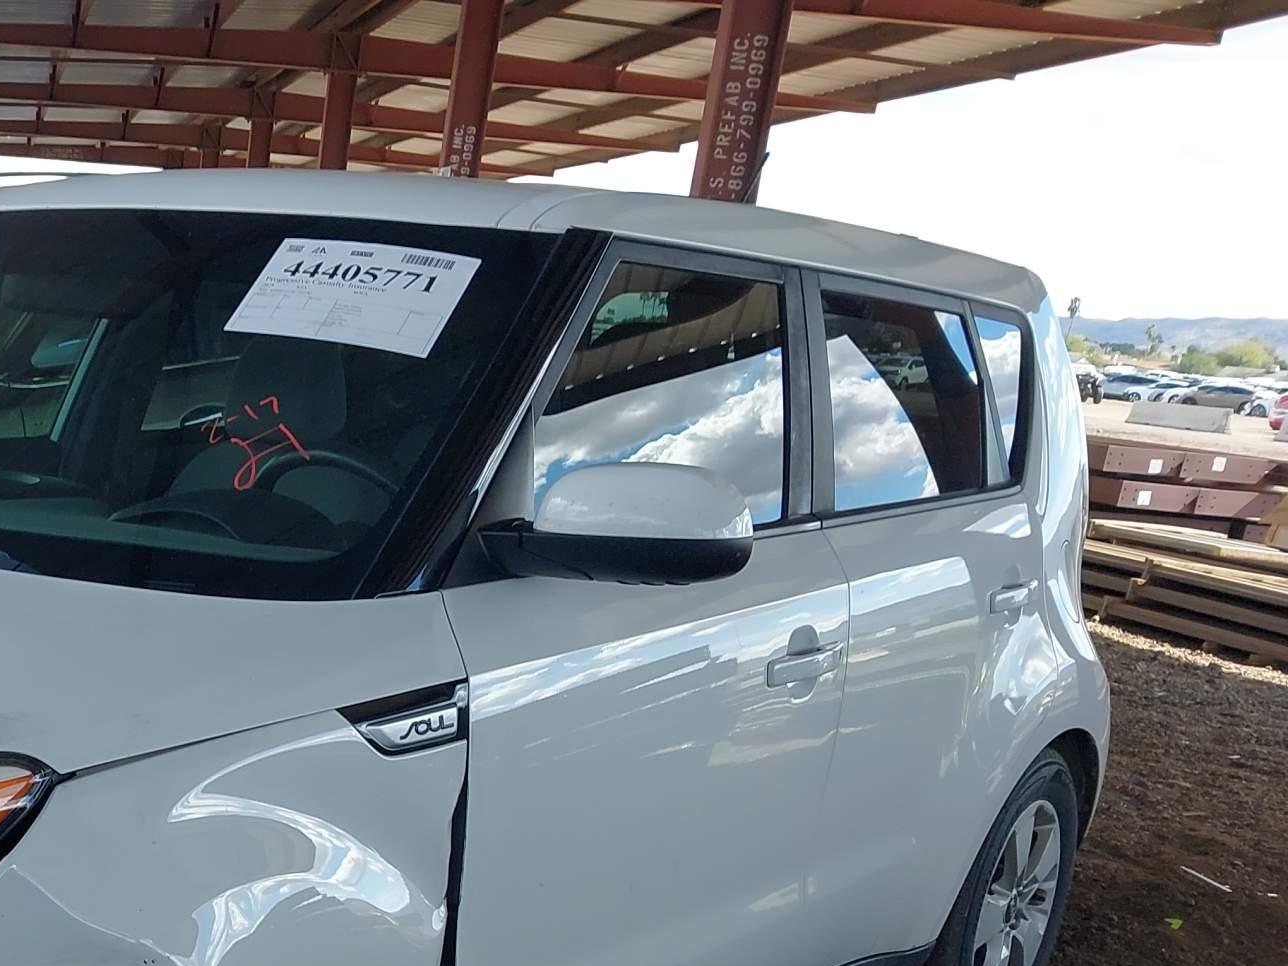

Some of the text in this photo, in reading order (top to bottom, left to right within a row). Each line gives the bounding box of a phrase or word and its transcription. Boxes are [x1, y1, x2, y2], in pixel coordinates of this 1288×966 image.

[714, 81, 742, 160] PREFAB
[730, 32, 751, 71] INC.
[728, 35, 769, 200] -866-799-0969
[283, 259, 438, 295] 44405771
[399, 714, 455, 740] SOUL
